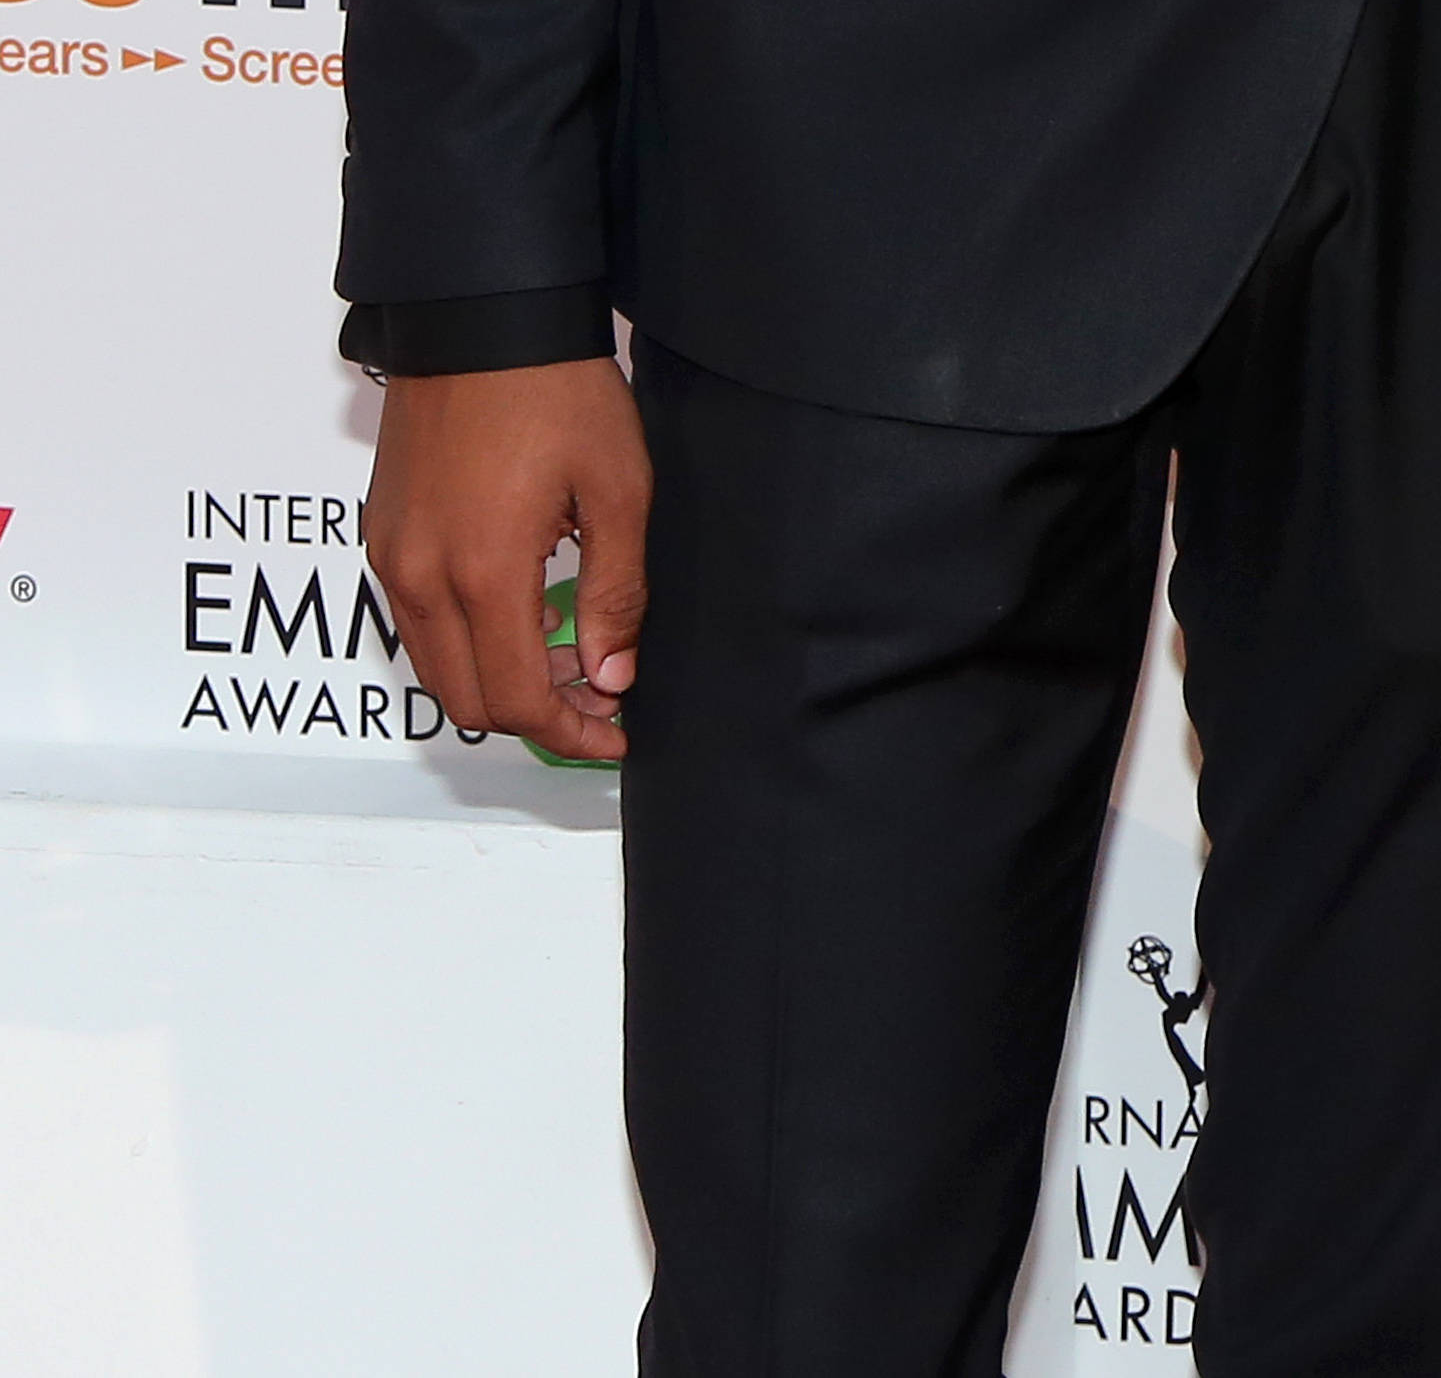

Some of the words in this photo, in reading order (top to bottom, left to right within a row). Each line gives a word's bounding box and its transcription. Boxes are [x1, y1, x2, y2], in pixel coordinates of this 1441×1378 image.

[0, 38, 109, 77] ears
[202, 36, 343, 88] Scree
[185, 562, 399, 661] EMM
[1074, 1282, 1198, 1345] ARD
